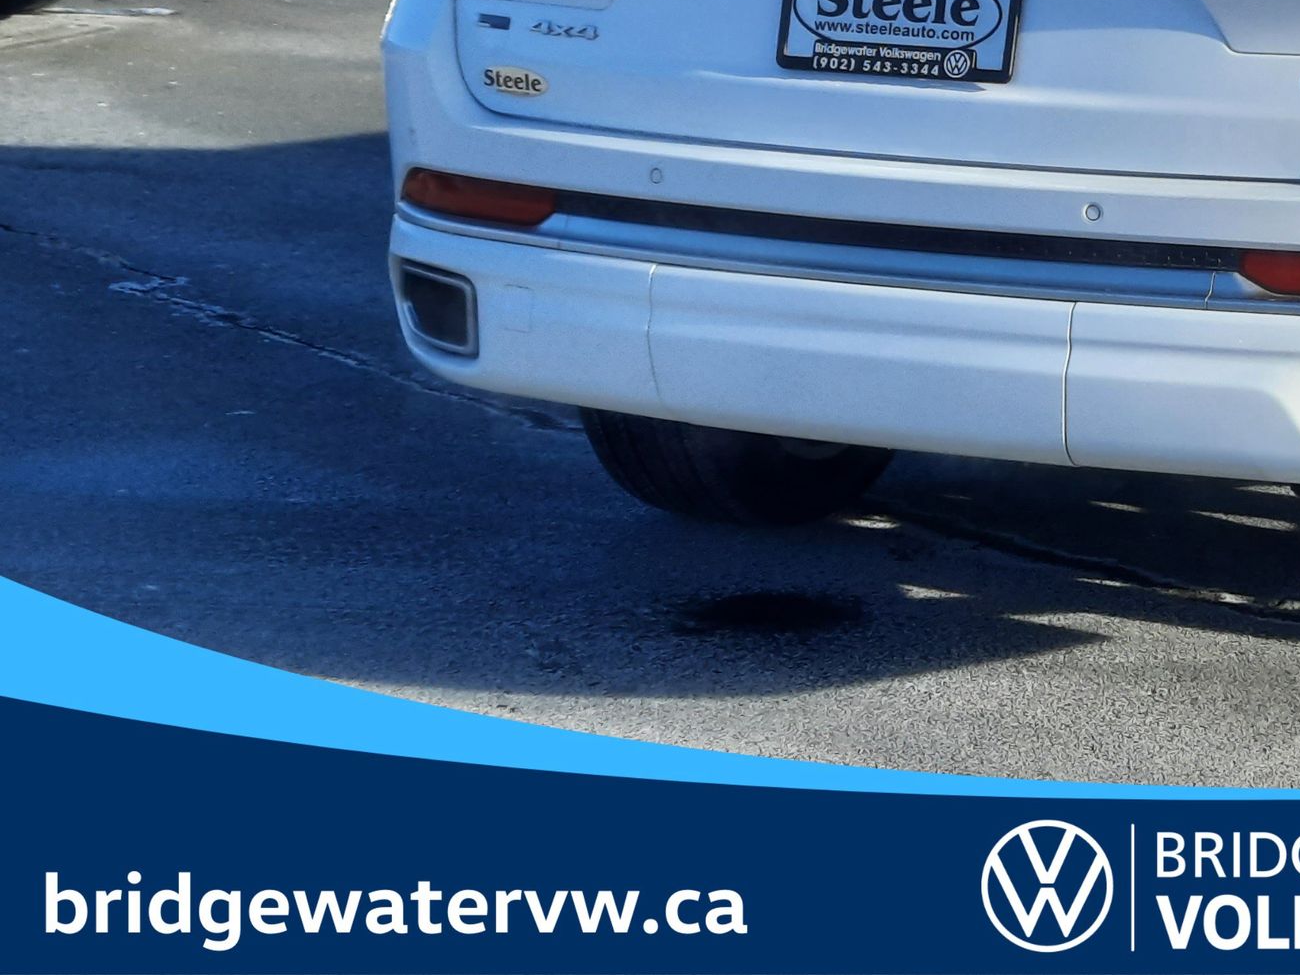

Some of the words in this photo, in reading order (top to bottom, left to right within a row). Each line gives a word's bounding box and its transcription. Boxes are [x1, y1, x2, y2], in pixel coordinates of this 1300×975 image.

[530, 19, 600, 41] 4x4
[815, 20, 975, 42] www.steeleauto.com
[814, 42, 877, 58] Bridgewater
[879, 46, 942, 63] Volkswagen
[813, 55, 855, 71] (902)
[862, 60, 940, 76] 543-3344
[484, 69, 543, 92] Steele
